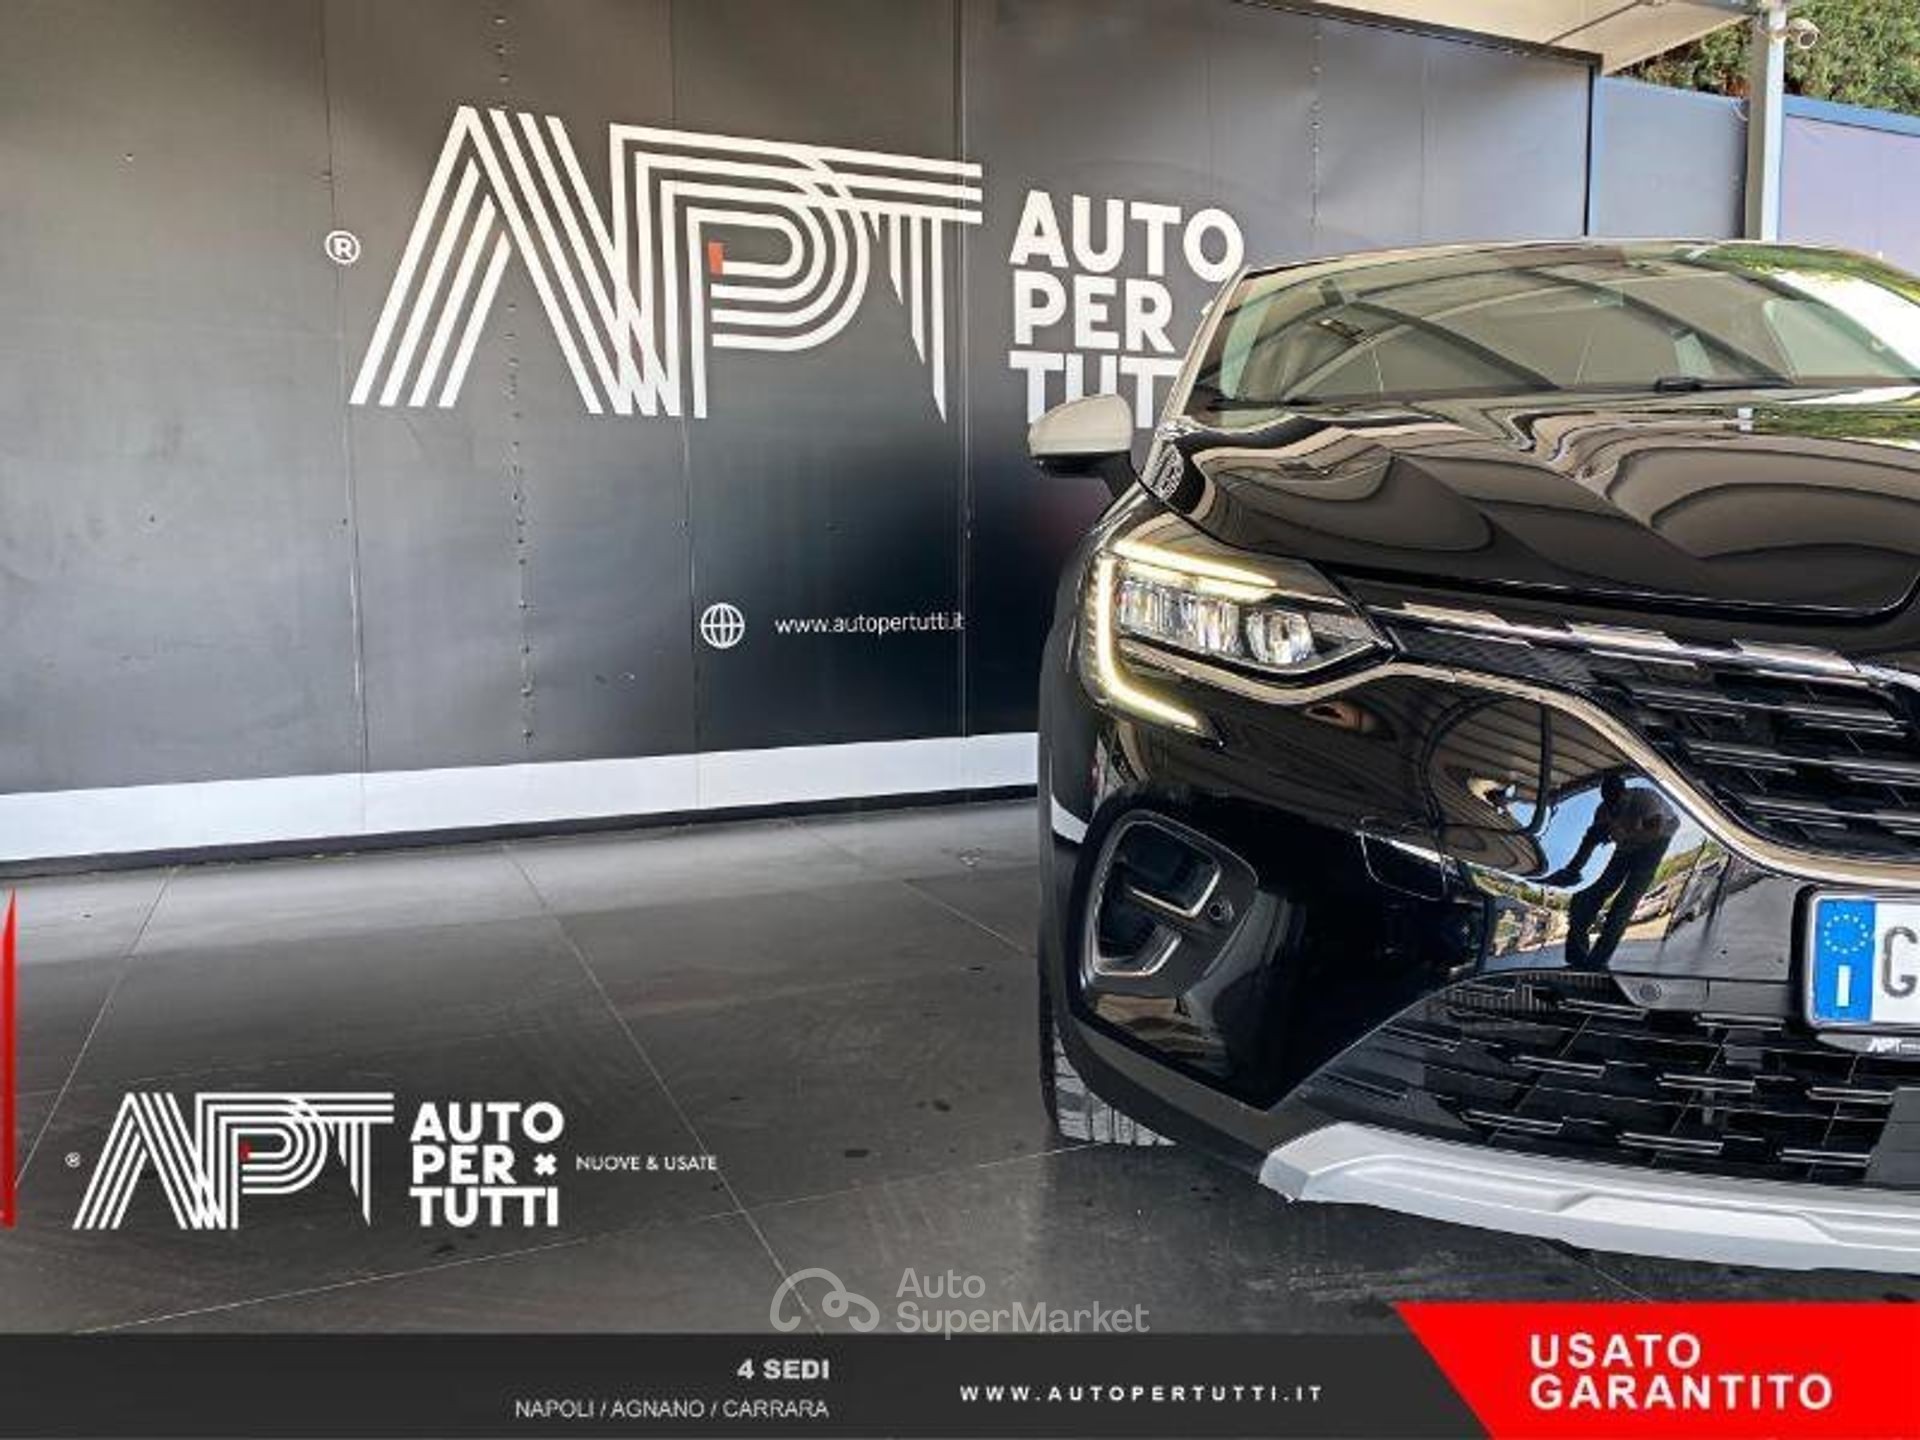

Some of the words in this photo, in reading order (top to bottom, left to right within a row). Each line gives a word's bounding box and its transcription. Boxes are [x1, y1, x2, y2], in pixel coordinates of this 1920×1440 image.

[1009, 189, 1244, 282] AUTO
[1014, 269, 1175, 353] PER
[1009, 350, 1186, 429] TUT
[774, 611, 965, 636] www.autopertutti.it
